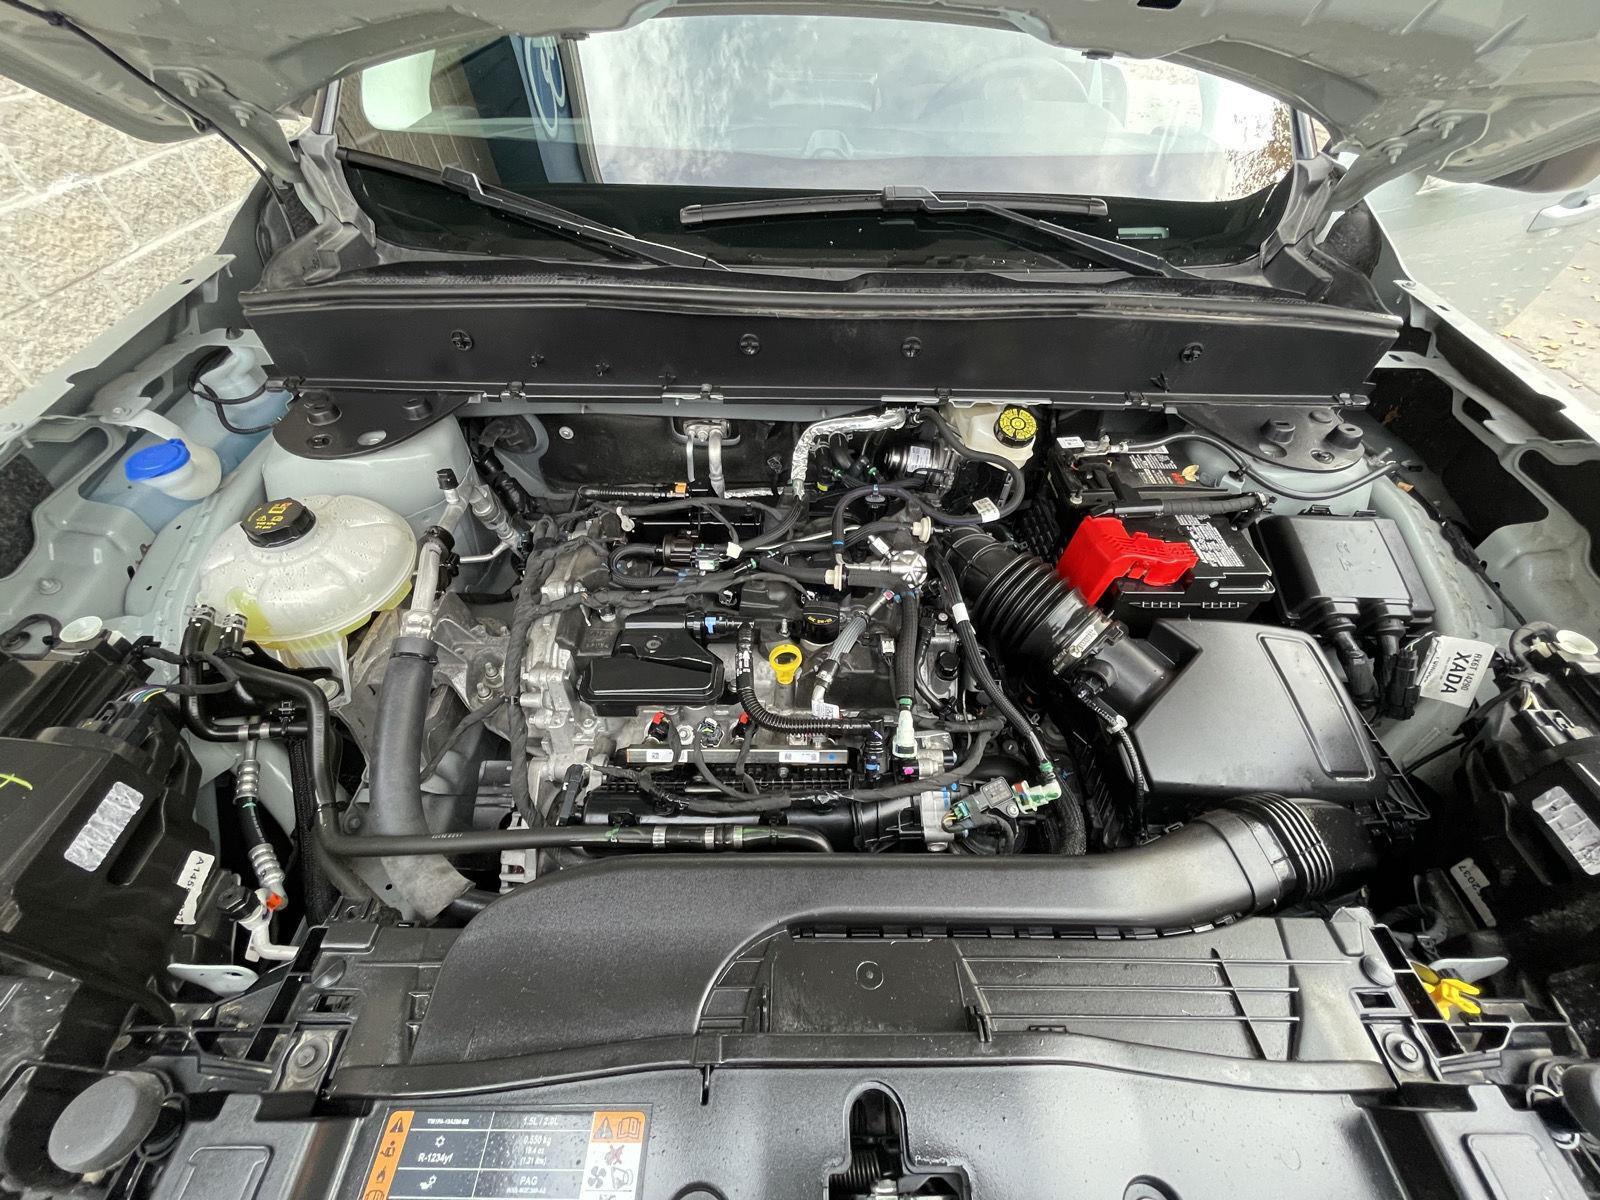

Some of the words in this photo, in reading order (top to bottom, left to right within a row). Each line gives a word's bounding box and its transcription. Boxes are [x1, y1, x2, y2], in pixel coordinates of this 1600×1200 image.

[1440, 651, 1472, 693] XADA
[186, 856, 204, 891] A145
[418, 1152, 454, 1165] R-1234yf
[520, 1176, 538, 1186] PAG
